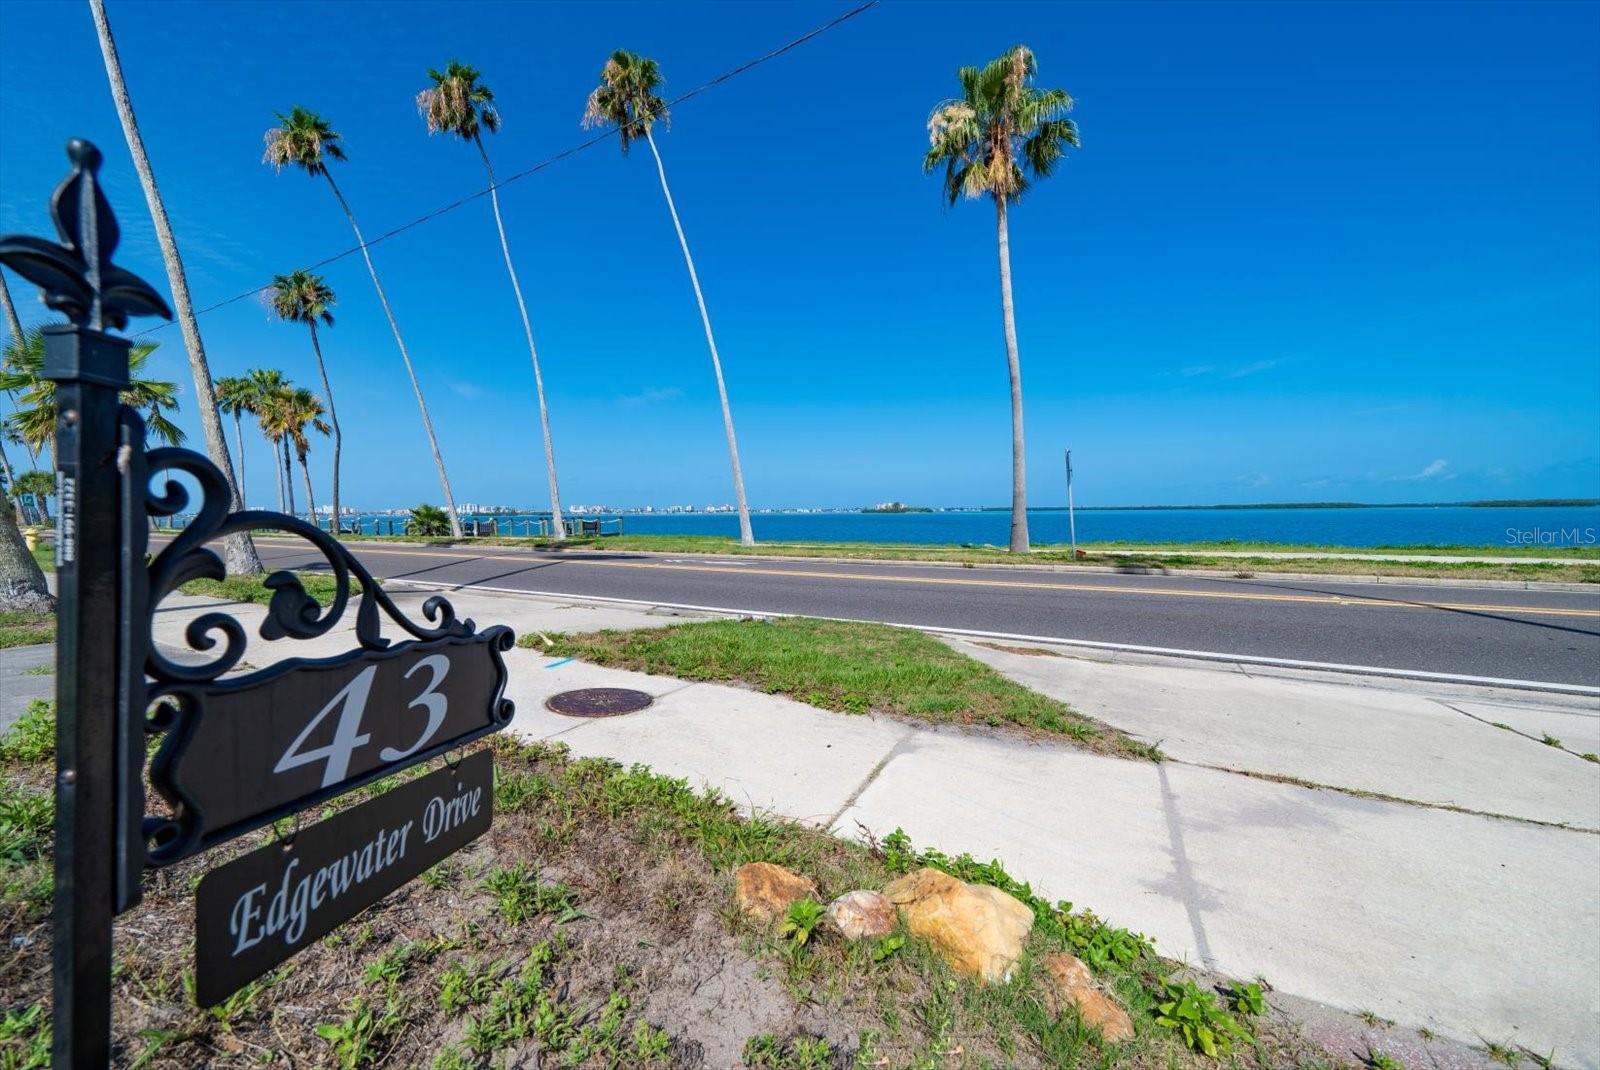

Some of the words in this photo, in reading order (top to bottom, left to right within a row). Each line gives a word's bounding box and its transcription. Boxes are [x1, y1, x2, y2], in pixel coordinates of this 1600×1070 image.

[273, 654, 451, 789] 43
[230, 820, 413, 957] Edgewater
[422, 781, 482, 844] Drive
